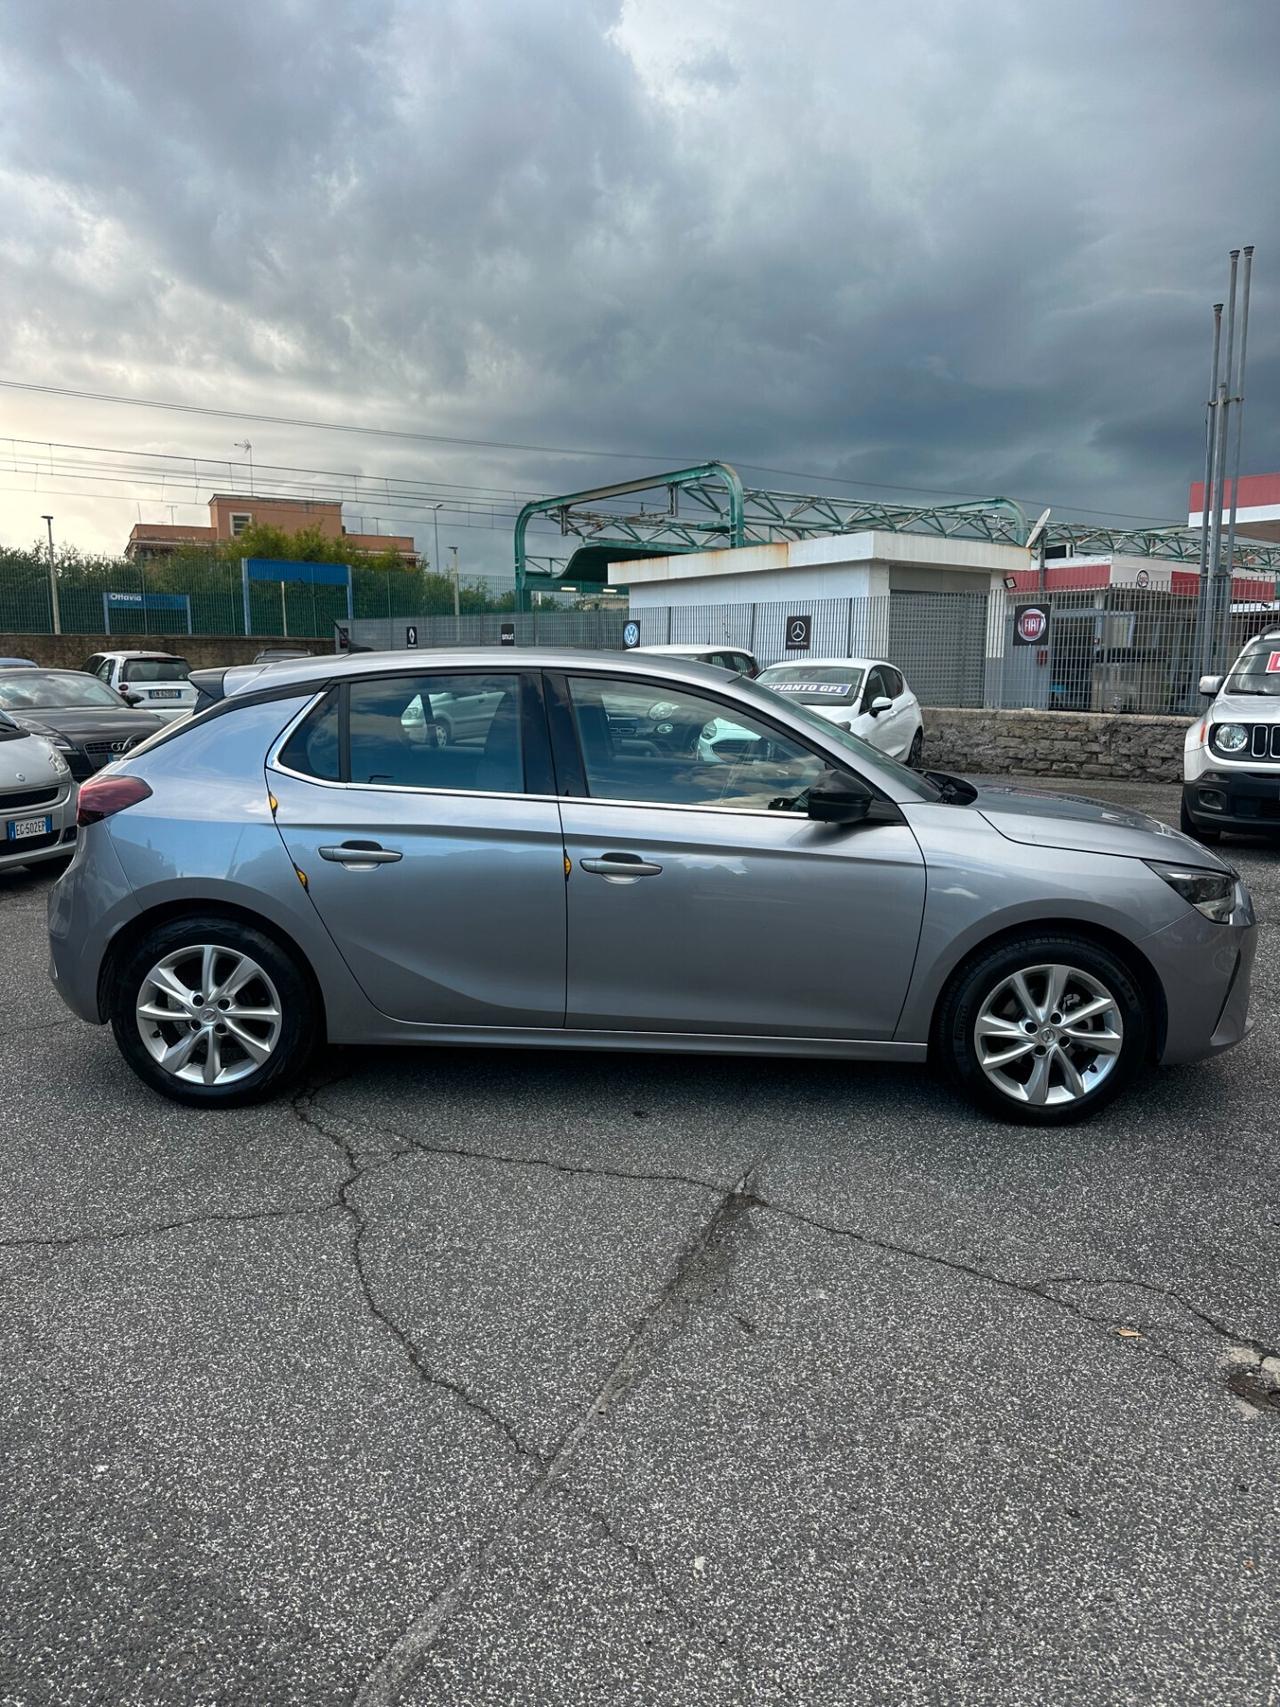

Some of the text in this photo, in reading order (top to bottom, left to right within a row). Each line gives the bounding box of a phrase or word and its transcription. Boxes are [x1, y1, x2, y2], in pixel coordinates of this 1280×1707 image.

[110, 593, 142, 602] Ottavia
[1024, 618, 1041, 633] FIAT
[768, 683, 843, 693] PIANTO GPL
